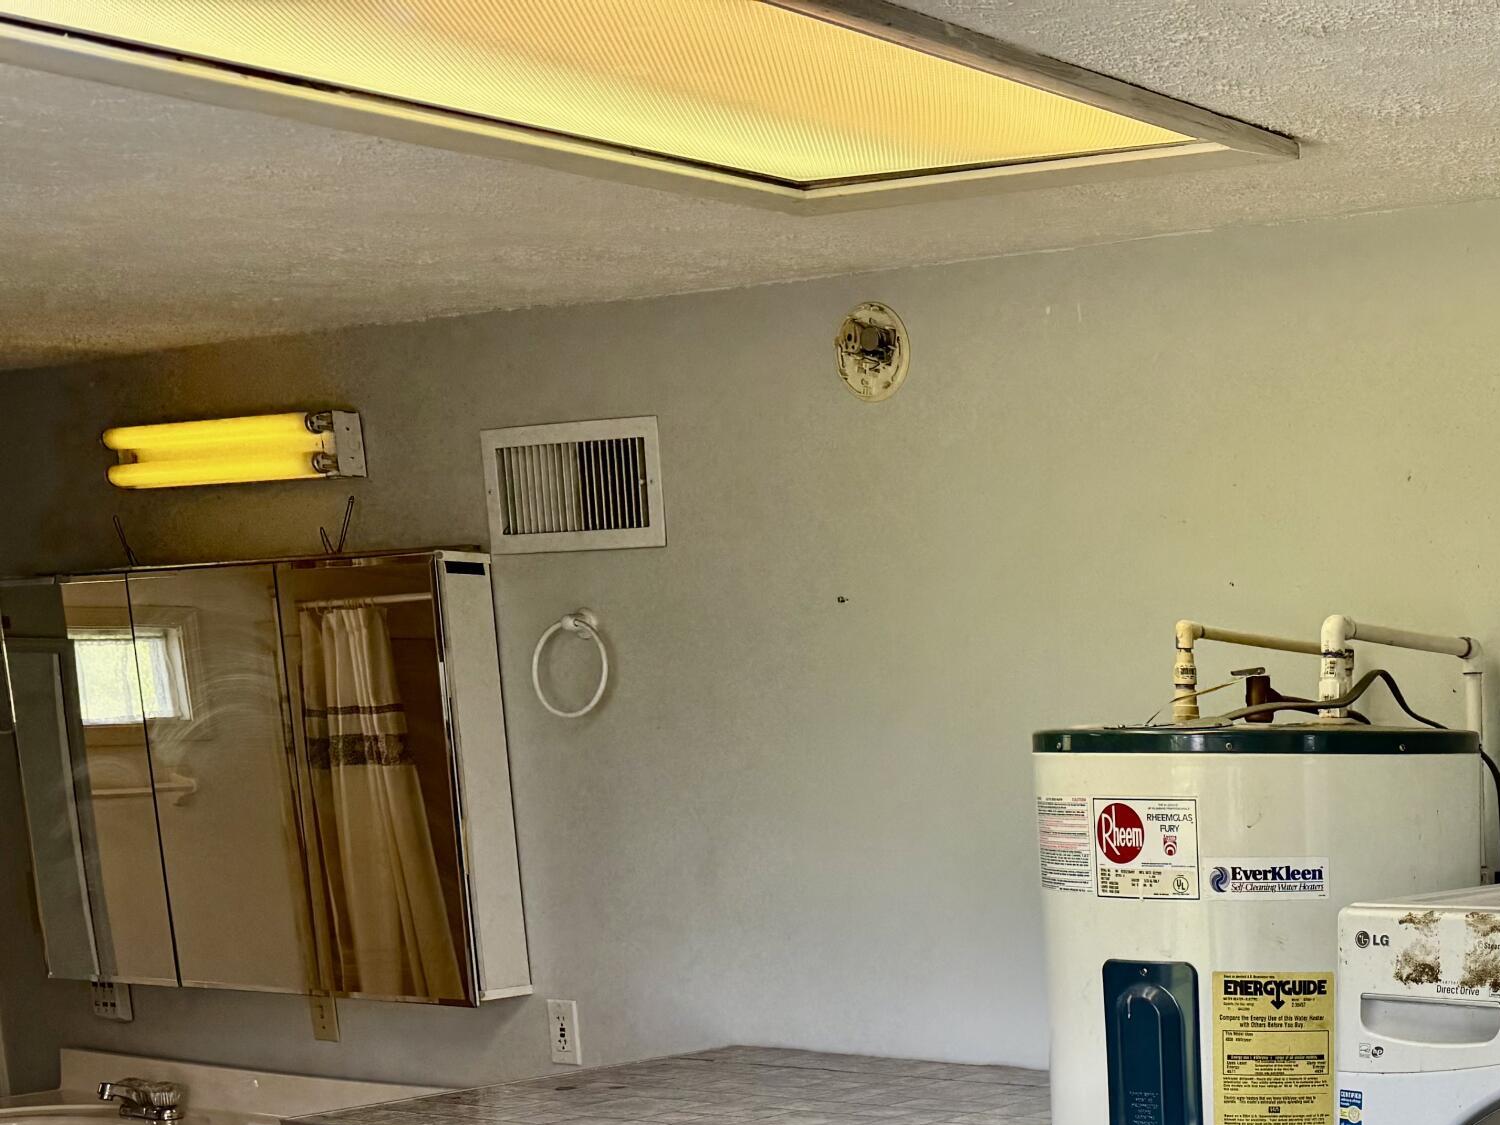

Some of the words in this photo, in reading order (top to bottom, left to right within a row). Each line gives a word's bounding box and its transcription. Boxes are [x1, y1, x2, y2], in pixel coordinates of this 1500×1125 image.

[1101, 805, 1142, 856] Rheem
[1160, 824, 1180, 833] FURY
[1231, 865, 1324, 881] EverKleen
[1231, 882, 1277, 893] Self-Cleaning
[1278, 883, 1298, 892] Water
[1299, 882, 1324, 893] Heaters
[1372, 934, 1390, 946] LG
[1223, 979, 1328, 996] ENERGYGUIDE
[1436, 985, 1458, 995] Direct
[1460, 986, 1480, 996] Drive
